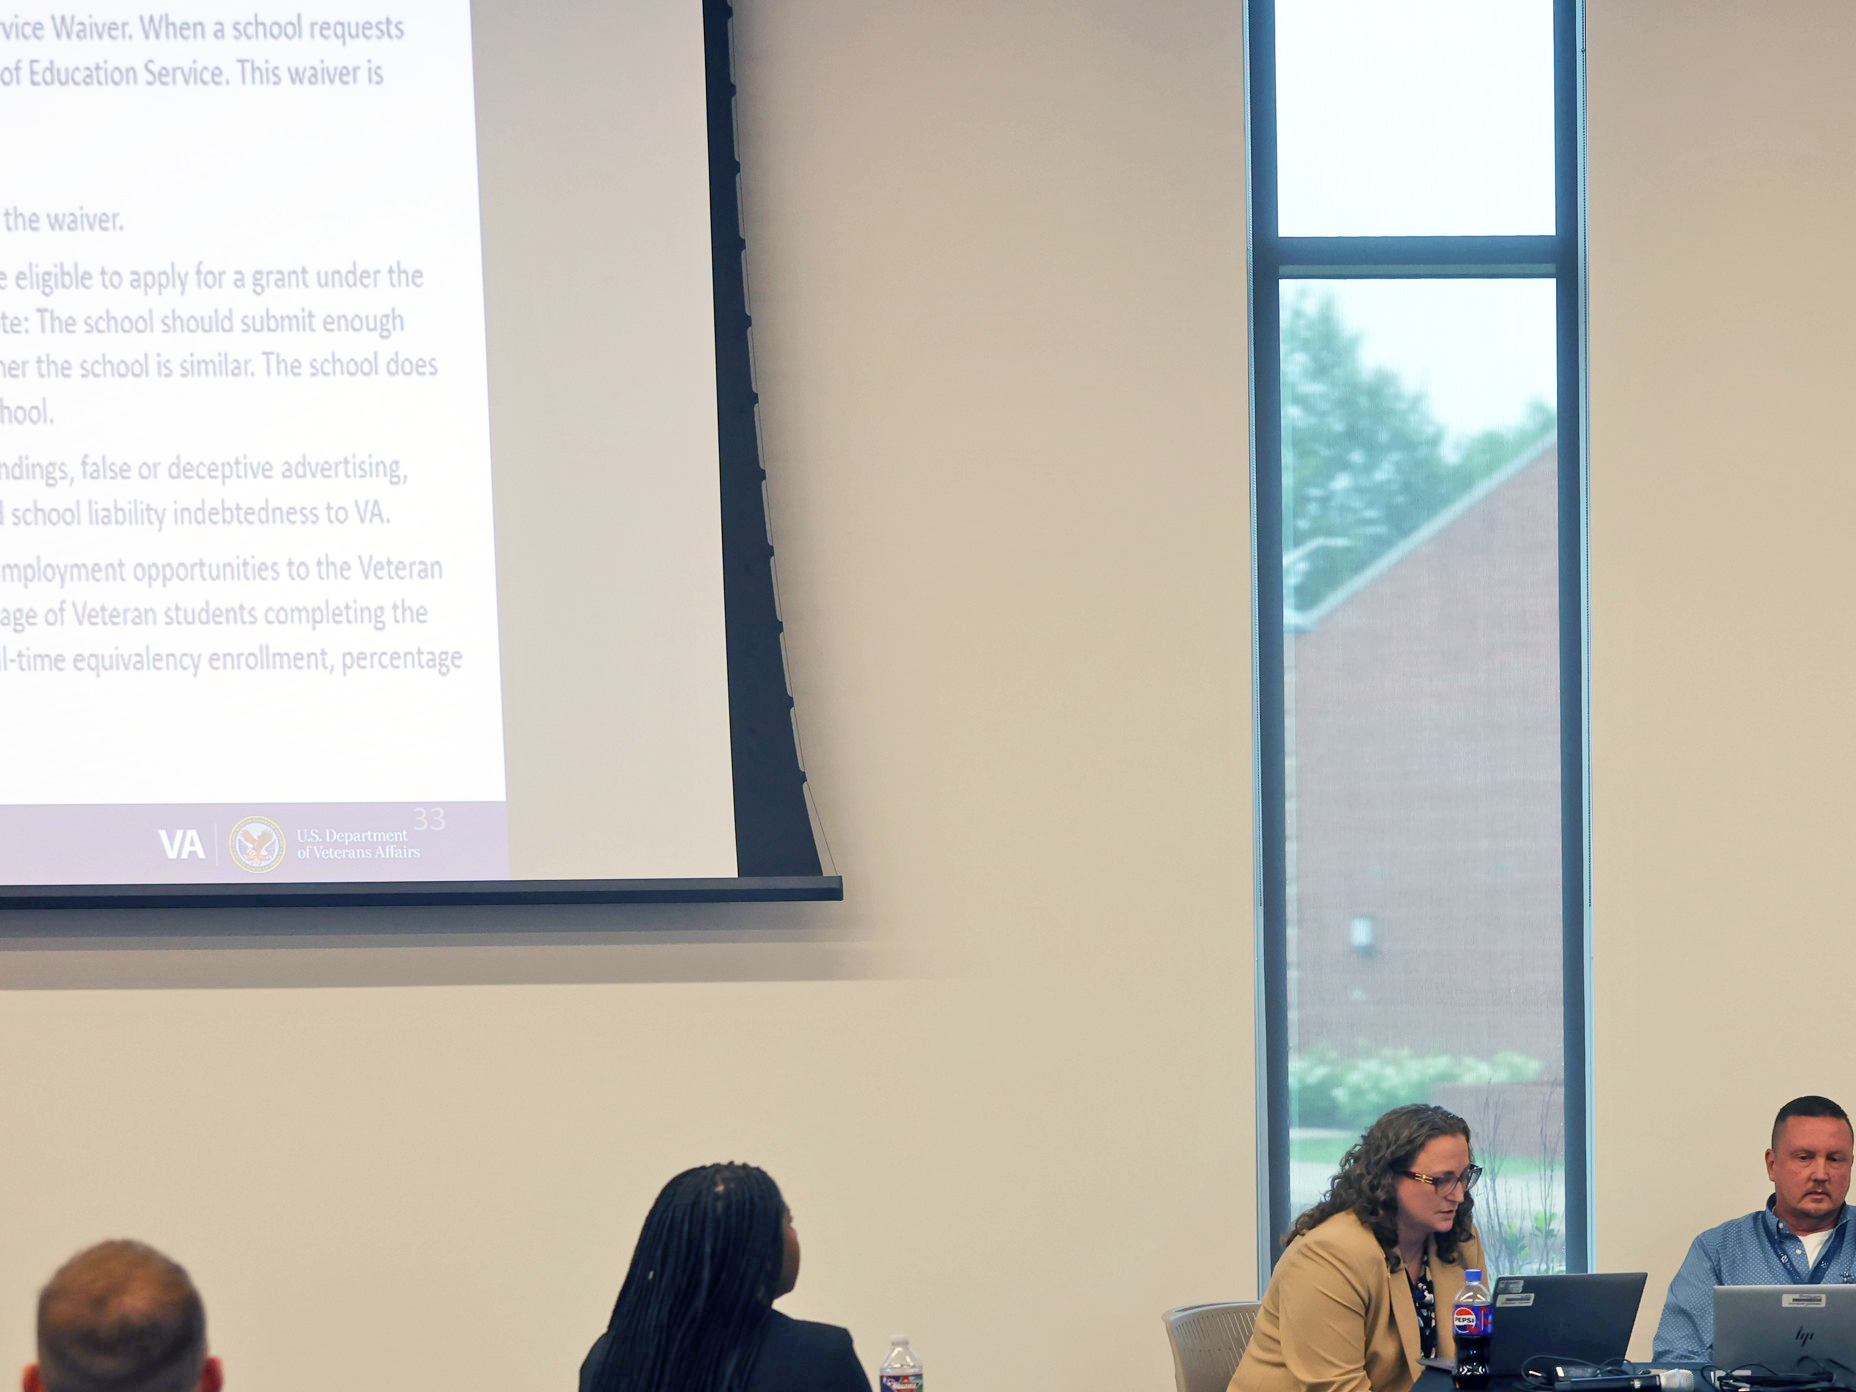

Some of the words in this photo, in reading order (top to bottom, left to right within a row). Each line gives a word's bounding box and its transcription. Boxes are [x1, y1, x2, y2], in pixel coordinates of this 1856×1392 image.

[0, 14, 45, 41] vice
[50, 13, 133, 41] Waiver.
[139, 12, 206, 42] When
[212, 20, 226, 41] a
[232, 12, 303, 41] school
[309, 15, 405, 47] requests
[0, 58, 23, 87] of
[28, 58, 139, 87] Education
[143, 59, 230, 87] Service.
[235, 57, 282, 86] This
[287, 58, 361, 86] waiver
[367, 58, 384, 86] is
[3, 205, 40, 232] the
[46, 206, 124, 232] waiver.
[15, 261, 93, 298] eligible
[99, 266, 123, 290] to
[129, 261, 189, 296] apply
[195, 260, 227, 289] for
[233, 269, 246, 289] a
[252, 265, 310, 296] grant
[316, 260, 381, 289] under
[387, 260, 424, 288] the
[0, 311, 29, 335] te:
[35, 307, 77, 334] The
[83, 308, 154, 334] school
[160, 307, 234, 334] should
[240, 307, 316, 333] submit
[322, 306, 405, 340] enough
[35, 353, 73, 379] the
[79, 352, 150, 379] school
[156, 352, 173, 378] is
[179, 352, 255, 378] similar.
[261, 351, 302, 378] The
[309, 351, 379, 377] school
[386, 351, 439, 377] does
[80, 453, 131, 480] false
[138, 461, 161, 480] or
[168, 454, 274, 486] deceptive
[281, 453, 408, 486] advertising,
[11, 499, 81, 527] school
[88, 499, 167, 533] liability
[174, 498, 320, 526] indebtedness
[325, 502, 349, 525] to
[354, 499, 390, 524] VA.
[1, 555, 126, 589] mployment
[133, 555, 280, 588] opportunities
[286, 558, 310, 581] to
[316, 553, 352, 581] the
[357, 554, 443, 580] Veteran
[0, 607, 38, 634] age
[44, 599, 67, 627] of
[71, 600, 157, 626] Veteran
[164, 600, 258, 626] students
[264, 599, 386, 632] completing
[391, 598, 428, 624] the
[0, 645, 66, 672] l-time
[72, 644, 202, 678] equivalency
[208, 644, 334, 675] enrollment,
[342, 646, 463, 677] percentage
[412, 807, 447, 832] 33
[158, 829, 207, 860] VA
[297, 829, 323, 843] U.S.
[325, 828, 408, 845] Department
[297, 845, 311, 860] of
[310, 845, 373, 860] Veterans
[375, 844, 421, 860] Affairs
[1455, 1316, 1475, 1324] PEPSI
